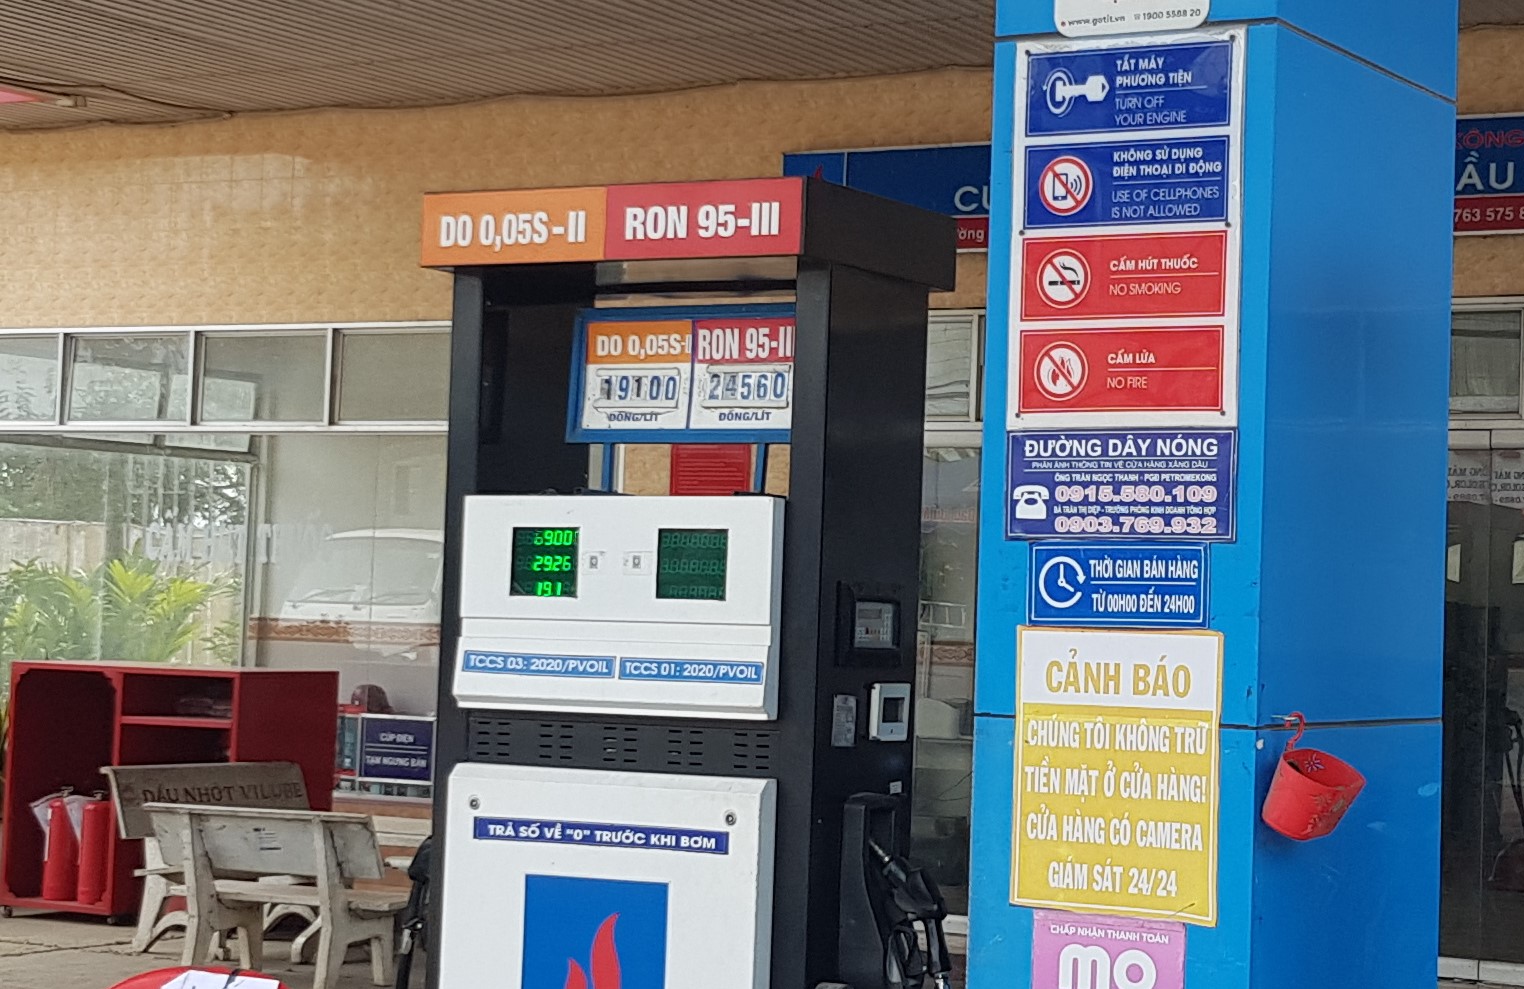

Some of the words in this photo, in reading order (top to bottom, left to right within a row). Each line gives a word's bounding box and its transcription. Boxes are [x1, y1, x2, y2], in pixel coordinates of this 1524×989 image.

[1190, 9, 1200, 17] 20
[1116, 55, 1134, 72] TẮT
[1139, 57, 1164, 70] MÁY
[1116, 73, 1165, 87] PHƯƠNG
[1169, 69, 1192, 87] TIỆN
[1115, 98, 1141, 110] TURN
[1144, 96, 1164, 108] OFF
[1115, 113, 1144, 125] YOUR
[1147, 110, 1186, 124] ENGINE
[1113, 149, 1152, 162] KHÔNG
[1155, 145, 1169, 160] SỬ
[1171, 147, 1202, 163] DỤNG
[1113, 164, 1137, 179] ĐIỆN
[1140, 164, 1171, 178] THOẠI
[1175, 164, 1186, 174] DI
[1189, 160, 1221, 175] ĐỘNG
[1112, 191, 1130, 202] USE
[1134, 189, 1148, 201] OF
[1151, 187, 1219, 200] CELLPHONES
[1112, 207, 1120, 218] IS
[1123, 206, 1144, 217] NOT
[1148, 204, 1200, 217] ALLOWED
[1486, 208, 1514, 220] 575
[625, 205, 687, 240] RON
[697, 201, 780, 238] 95-III
[439, 215, 472, 248] DO
[1110, 257, 1134, 271] CẤM
[1138, 256, 1157, 270] HÚT
[1161, 254, 1198, 269] THUỐC
[1109, 284, 1127, 295] NO
[1130, 282, 1181, 295] SMOKING
[596, 335, 622, 356] DO
[698, 328, 739, 360] RON
[1108, 349, 1133, 364] CẤM
[1136, 349, 1155, 363] LỬA
[603, 375, 678, 401] 19100
[708, 372, 786, 401] 24560
[1107, 378, 1124, 388] NO
[1127, 377, 1147, 388] FIRE
[1025, 436, 1102, 457] ĐƯỜNG
[1108, 435, 1151, 456] DÂY
[1157, 434, 1218, 455] NÓNG
[1055, 485, 1217, 502] 0915.580.109
[1055, 517, 1217, 533] 0903.769.932
[1089, 555, 1112, 578] THỜI
[1115, 560, 1140, 578] GIAN
[1143, 555, 1166, 578] BÁN
[1168, 556, 1198, 578] HÀNG
[1092, 589, 1108, 612] TỪ
[1108, 595, 1137, 612] 00H00
[1140, 587, 1162, 612] ĐẾN
[1164, 595, 1194, 613] 24H00
[470, 656, 504, 668] TCCS
[508, 659, 527, 669] 03:
[530, 659, 609, 673] 2020/PVOIL
[625, 661, 658, 675] TCCS
[661, 664, 679, 676] 01:
[683, 664, 758, 679] 2020/PVOIL
[1046, 648, 1120, 695] CẢNH
[1132, 655, 1191, 698] BÁO
[1027, 714, 1080, 748] CHÚNG
[1084, 716, 1110, 749] TÔI
[1115, 719, 1169, 753] KHÔNG
[1175, 721, 1208, 755] TRỮ
[1024, 756, 1060, 794] TIỀN
[1065, 764, 1099, 803] MẶT
[1104, 760, 1117, 797] Ở
[1120, 762, 1151, 799] CỬA
[1157, 767, 1206, 803] HÀNG!
[488, 822, 515, 837] TRẢ
[519, 823, 541, 838] SỐ
[544, 823, 562, 839] VỀ
[595, 829, 647, 845] TRƯỚC
[650, 834, 675, 846] KHI
[681, 837, 715, 849] BƠM
[1026, 804, 1058, 840] CỬA
[1063, 809, 1105, 844] HÀNG
[1110, 812, 1131, 846] CÓ
[1136, 820, 1202, 851] CAMERA
[1048, 856, 1087, 889] GIÁM
[1092, 858, 1123, 892] SÁT
[1128, 867, 1177, 897] 24/24
[1051, 924, 1075, 934] CHẤP
[1078, 927, 1105, 939] NHẬN
[1107, 930, 1140, 941] THANH
[1142, 933, 1168, 944] TOÁN
